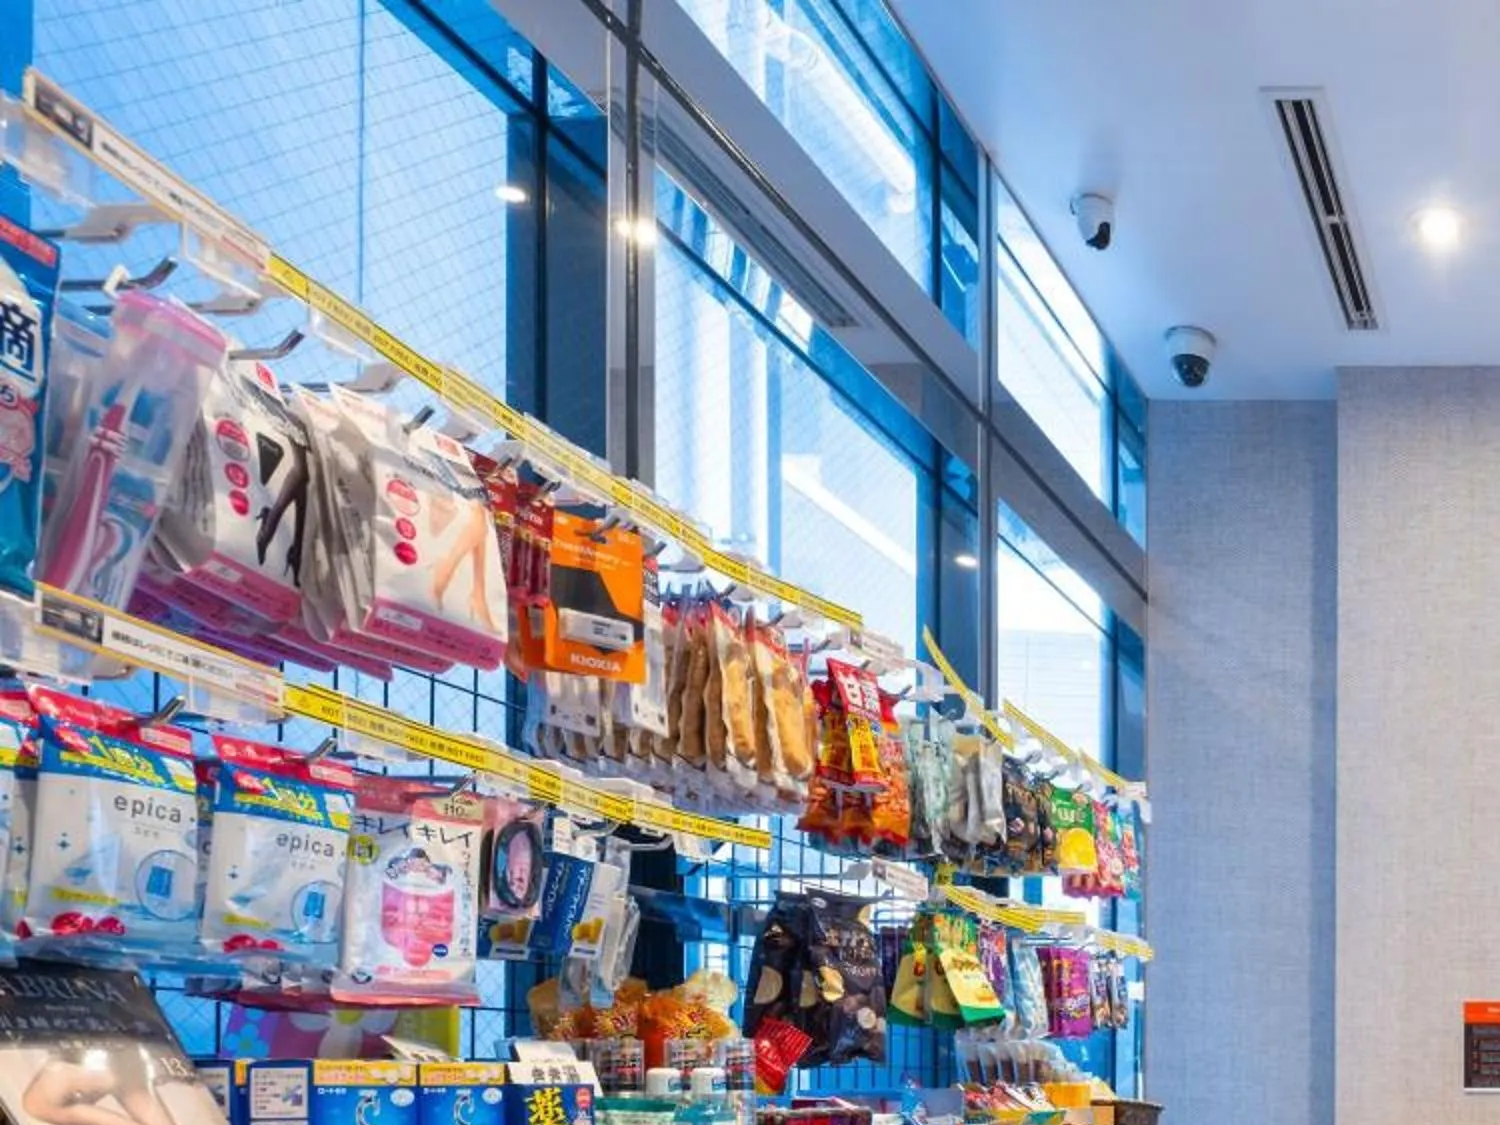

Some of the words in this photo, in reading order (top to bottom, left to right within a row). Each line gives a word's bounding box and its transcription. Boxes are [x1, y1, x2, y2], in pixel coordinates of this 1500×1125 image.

[569, 653, 622, 673] KIOXIA
[113, 794, 182, 824] epica
[275, 829, 335, 860] epica
[414, 825, 473, 849] キレイ
